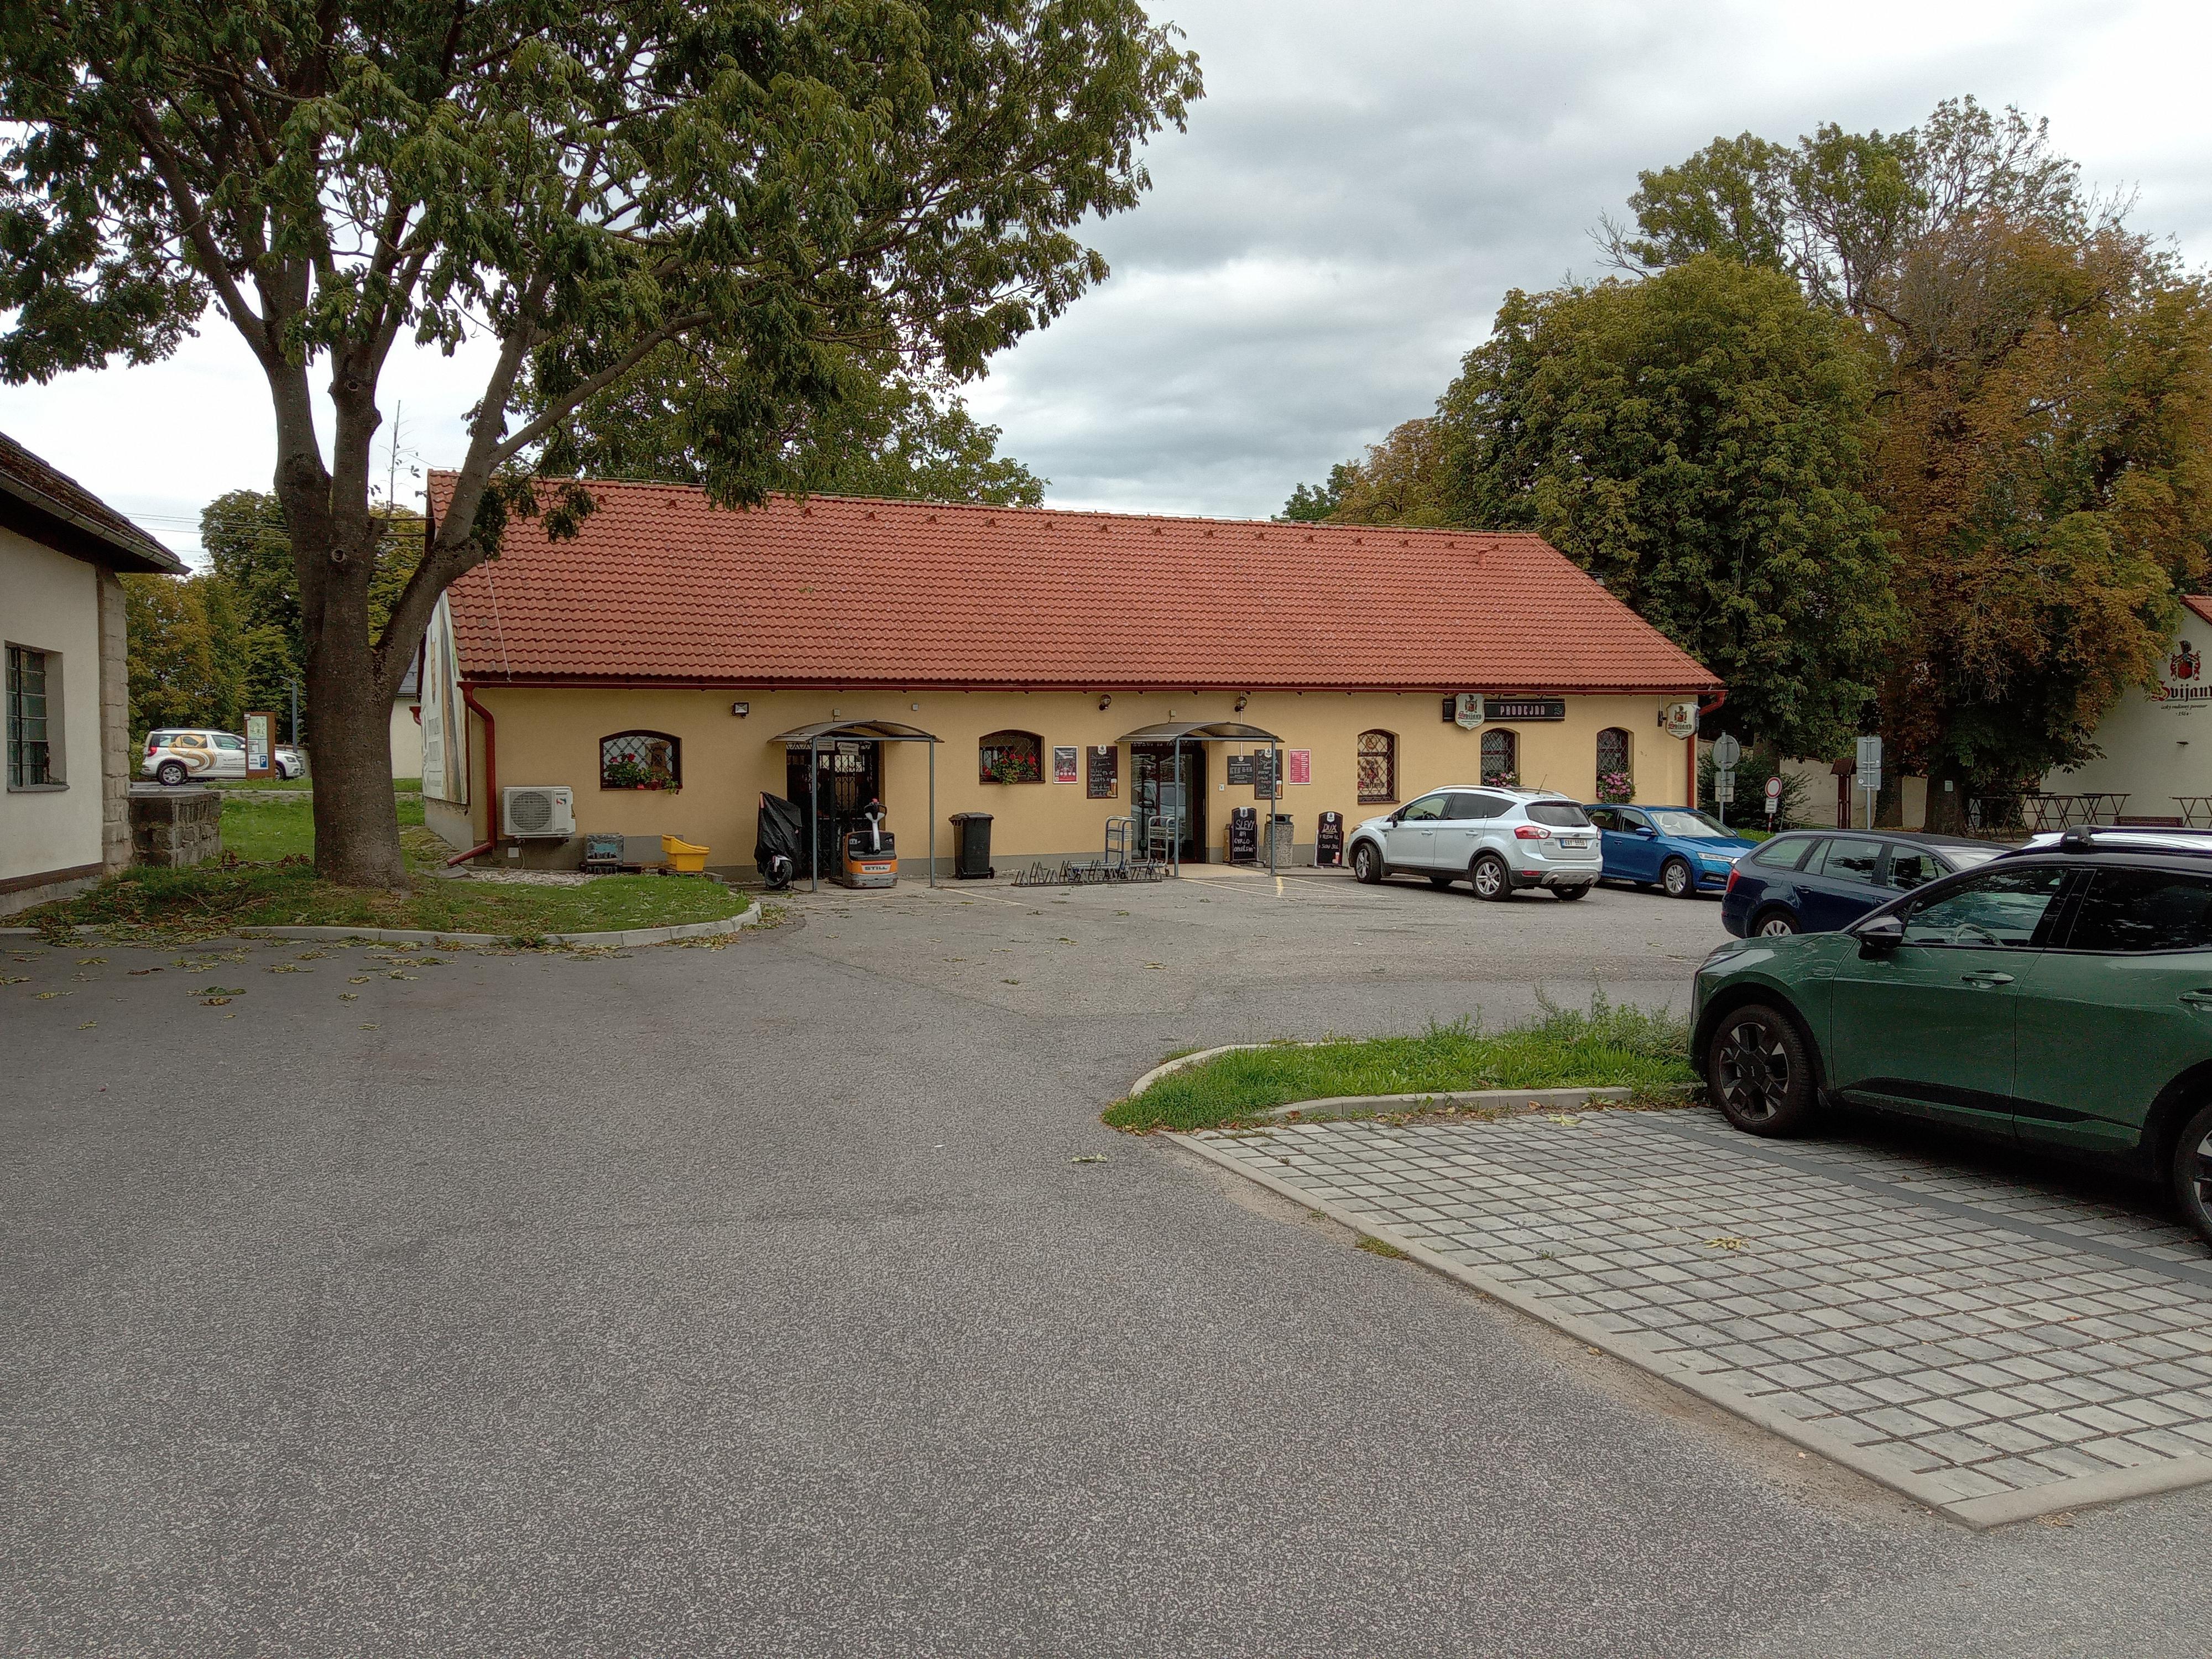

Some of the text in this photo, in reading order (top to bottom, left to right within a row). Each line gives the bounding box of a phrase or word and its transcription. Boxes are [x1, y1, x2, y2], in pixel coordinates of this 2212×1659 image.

[1458, 711, 1481, 719] Svijany
[1500, 705, 1546, 716] PRODEJNA
[1668, 721, 1692, 730] Svijany
[1235, 820, 1255, 830] SLEVY
[1323, 823, 1337, 832] DUX
